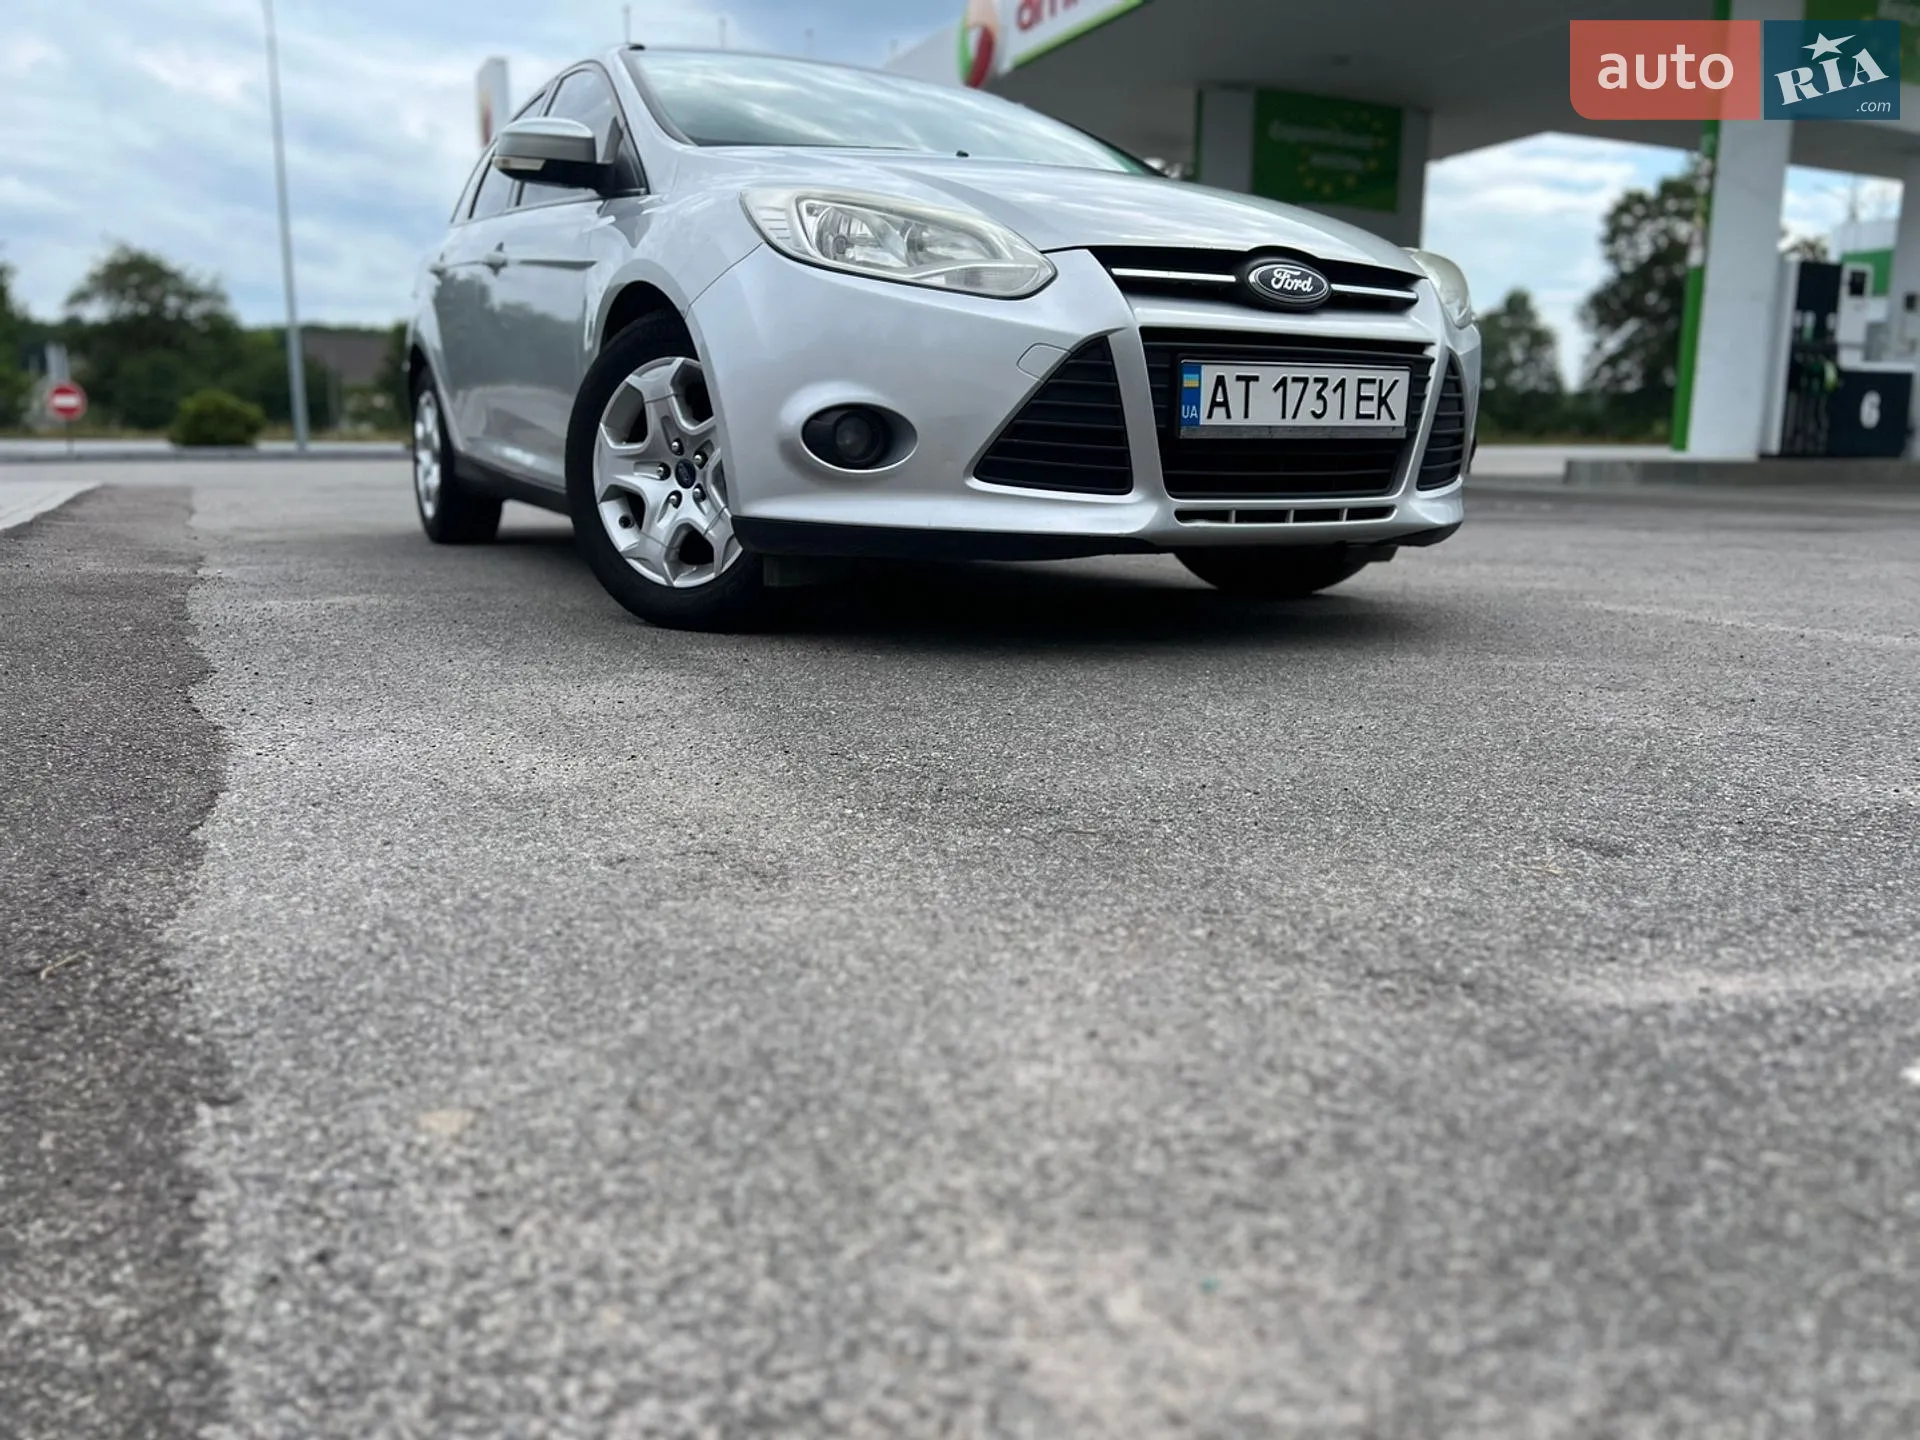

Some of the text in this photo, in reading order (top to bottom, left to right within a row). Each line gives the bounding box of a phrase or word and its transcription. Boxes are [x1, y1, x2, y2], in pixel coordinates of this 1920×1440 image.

[1271, 268, 1314, 293] Ford
[1181, 404, 1198, 419] UA
[1206, 374, 1260, 420] AT
[1860, 389, 1882, 430] 6
